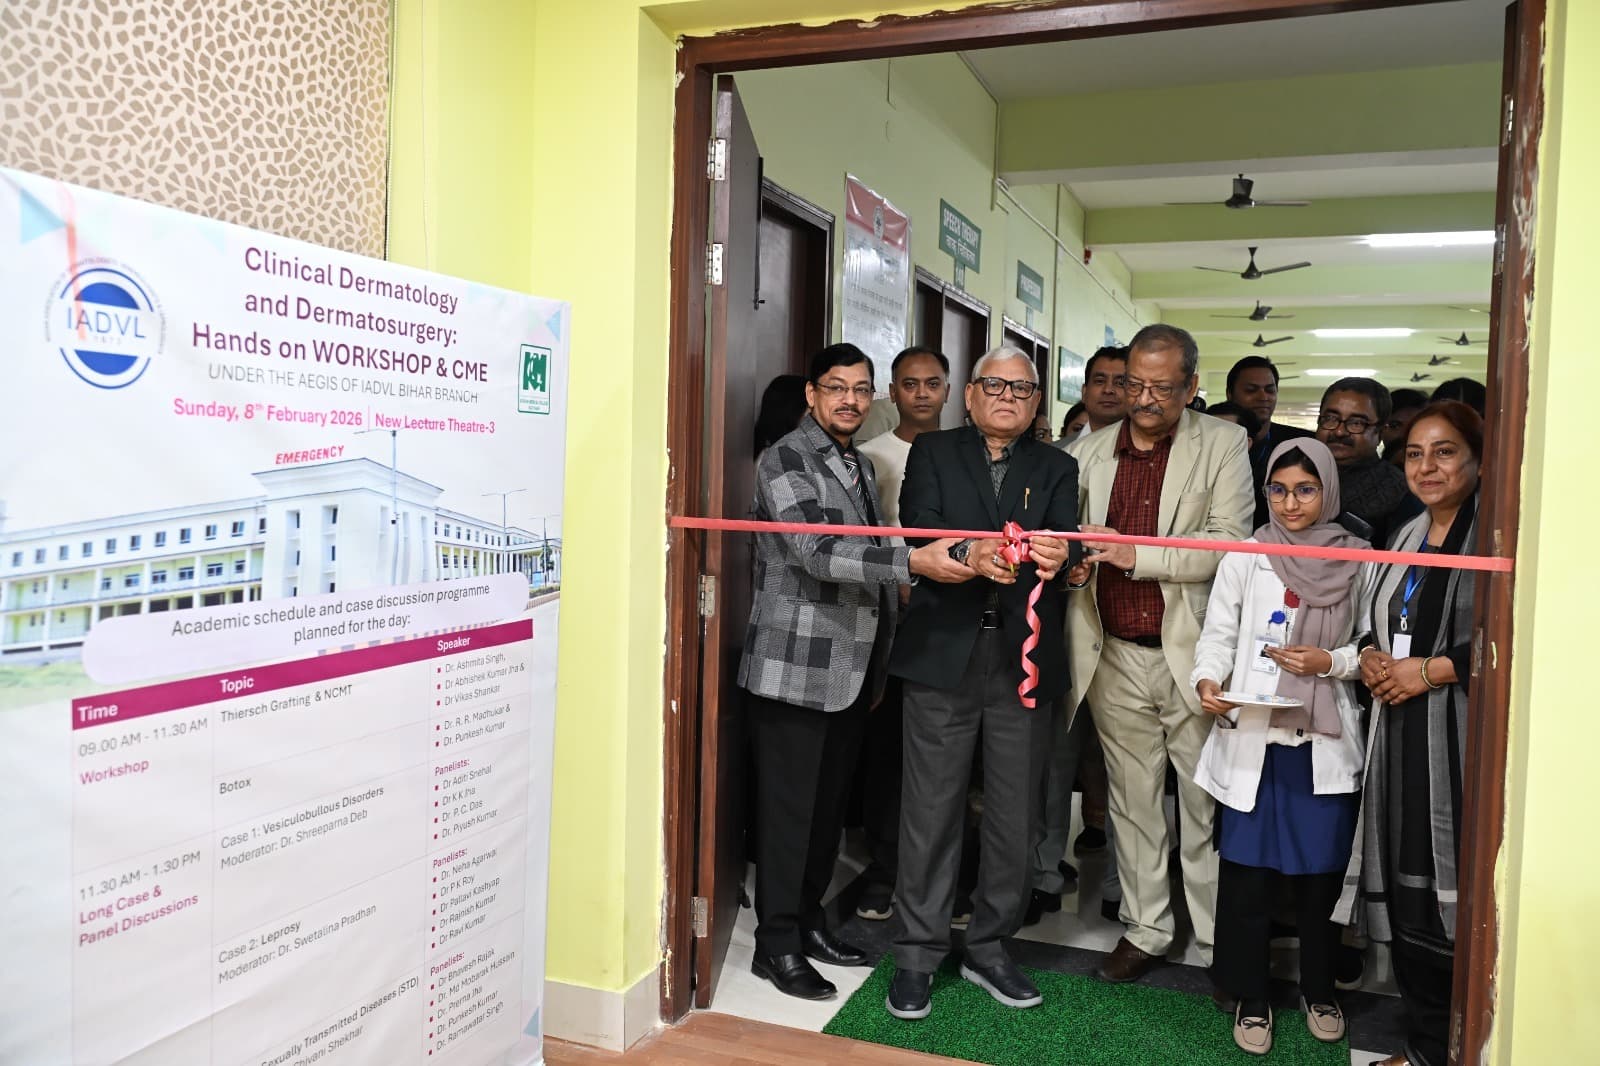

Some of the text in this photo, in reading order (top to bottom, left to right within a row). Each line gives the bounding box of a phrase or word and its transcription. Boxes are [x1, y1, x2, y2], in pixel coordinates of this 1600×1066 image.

[944, 207, 960, 237] SPEECH
[245, 247, 458, 315] Clinical Dermatology
[67, 307, 146, 338] IADVL
[245, 294, 457, 347] and Dermatosurgery:
[193, 322, 488, 382] Hands on WORKSHOP & CME
[208, 362, 478, 404] UNDER THE AEGIS OF IADVL BIHAR BRANCH
[174, 397, 239, 422] Sunday,
[267, 404, 327, 427] February
[330, 410, 363, 426] 2026
[375, 412, 495, 434] New Lecture Theatre-3
[275, 445, 345, 465] EMERGENCY
[171, 584, 490, 637] Academic schedule and case discussion programme
[294, 613, 411, 645] planned for the day:
[77, 636, 471, 722] Time Topic Speaker
[220, 684, 352, 723] Thiersch Grafting & NCMT
[78, 738, 117, 757] 09.00
[120, 731, 142, 748] AM
[152, 722, 187, 741] 11.30
[189, 717, 208, 732] AM
[79, 759, 149, 785] Workshop
[219, 778, 252, 795] Botox
[434, 759, 470, 776] Panelists:
[221, 832, 249, 849] Case
[262, 801, 341, 835] Vesiculobullous
[342, 786, 385, 808] Disorders
[220, 808, 368, 870] Moderator: Dr. Shreeparna Deb
[433, 848, 468, 868] Panelists:
[80, 878, 118, 900] 11.30
[120, 869, 141, 887] AM
[152, 858, 180, 876] 1.30
[182, 850, 201, 867] PM
[79, 895, 199, 947] Panel Discussions
[80, 884, 163, 925] Long Case &
[218, 920, 301, 964] Case 2: Leprosy
[218, 952, 277, 984] Moderator:
[278, 944, 292, 957] Dr.
[341, 904, 377, 928] Pradhan
[430, 952, 465, 977] Panelists:
[304, 1010, 358, 1049] Transmitted
[360, 990, 398, 1018] Diseases
[398, 976, 420, 997] (STD)
[328, 1025, 364, 1054] Shekhar
